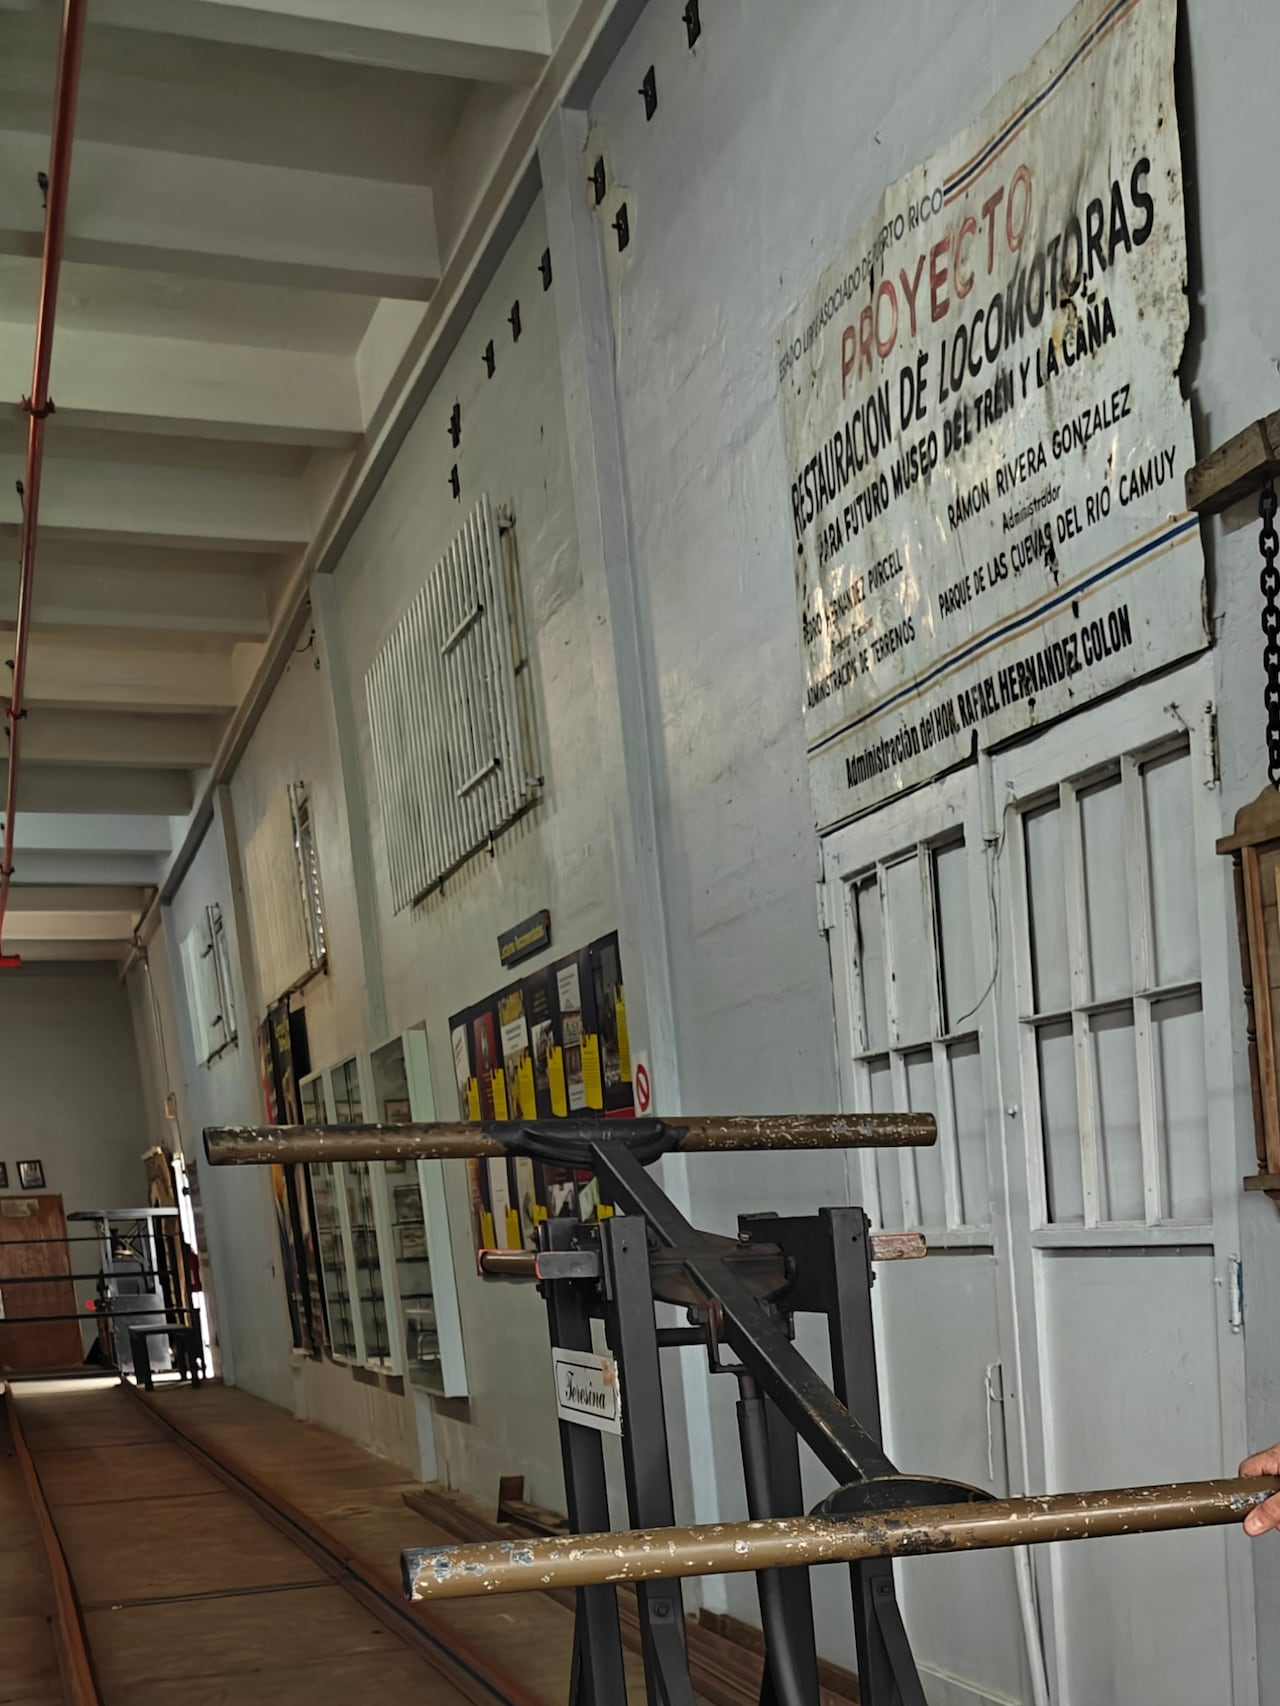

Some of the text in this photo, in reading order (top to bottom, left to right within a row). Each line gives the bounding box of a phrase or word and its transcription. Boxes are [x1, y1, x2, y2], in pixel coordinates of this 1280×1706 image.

[842, 163, 1032, 400] PROYECTO
[908, 187, 942, 232] RICO
[791, 156, 1154, 540] RESTAURACION DE LOCOMOTORAS
[818, 516, 844, 567] PARA
[844, 472, 889, 542] FUTURO
[891, 430, 938, 500] MUSEO
[944, 404, 973, 458] DEL
[974, 367, 1014, 433] TREN
[1020, 356, 1030, 398] Y
[1036, 338, 1059, 388] LA
[938, 445, 1176, 619] PARQUE DE LAS CUEVAS DEL RIO CAMUY
[948, 384, 1131, 531] RAMON RIVERA GONZALEZ
[1002, 484, 1061, 534] Administrador
[846, 723, 921, 789] Administración
[920, 711, 936, 751] del
[957, 675, 1000, 729] RAFAEL
[998, 632, 1082, 708] HERNANDEZ
[1080, 604, 1132, 667] COLON
[871, 616, 915, 664] TERRENOS
